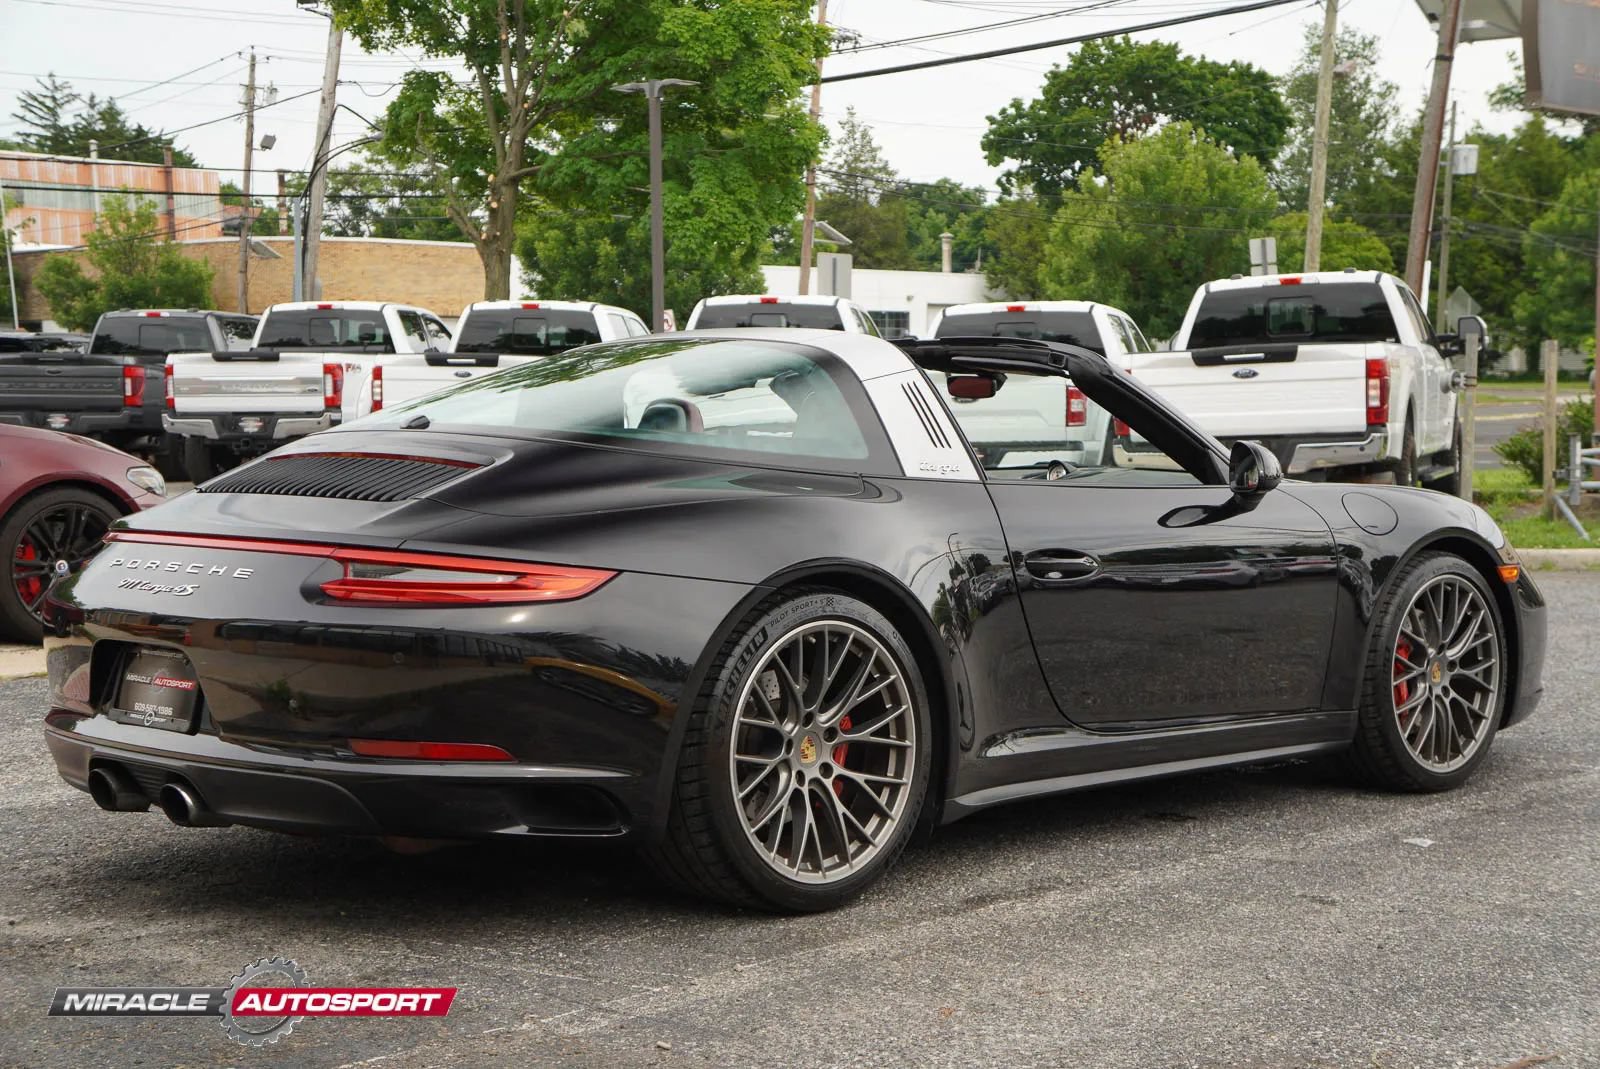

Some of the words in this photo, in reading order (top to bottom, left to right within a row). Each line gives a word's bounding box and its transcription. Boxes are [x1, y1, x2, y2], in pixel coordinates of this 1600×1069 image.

[110, 558, 254, 579] PORSCHE
[770, 610, 789, 627] PILOT
[791, 600, 814, 614] SPORT
[126, 674, 151, 684] MIRACLE
[154, 678, 193, 689] AUTOSPORT
